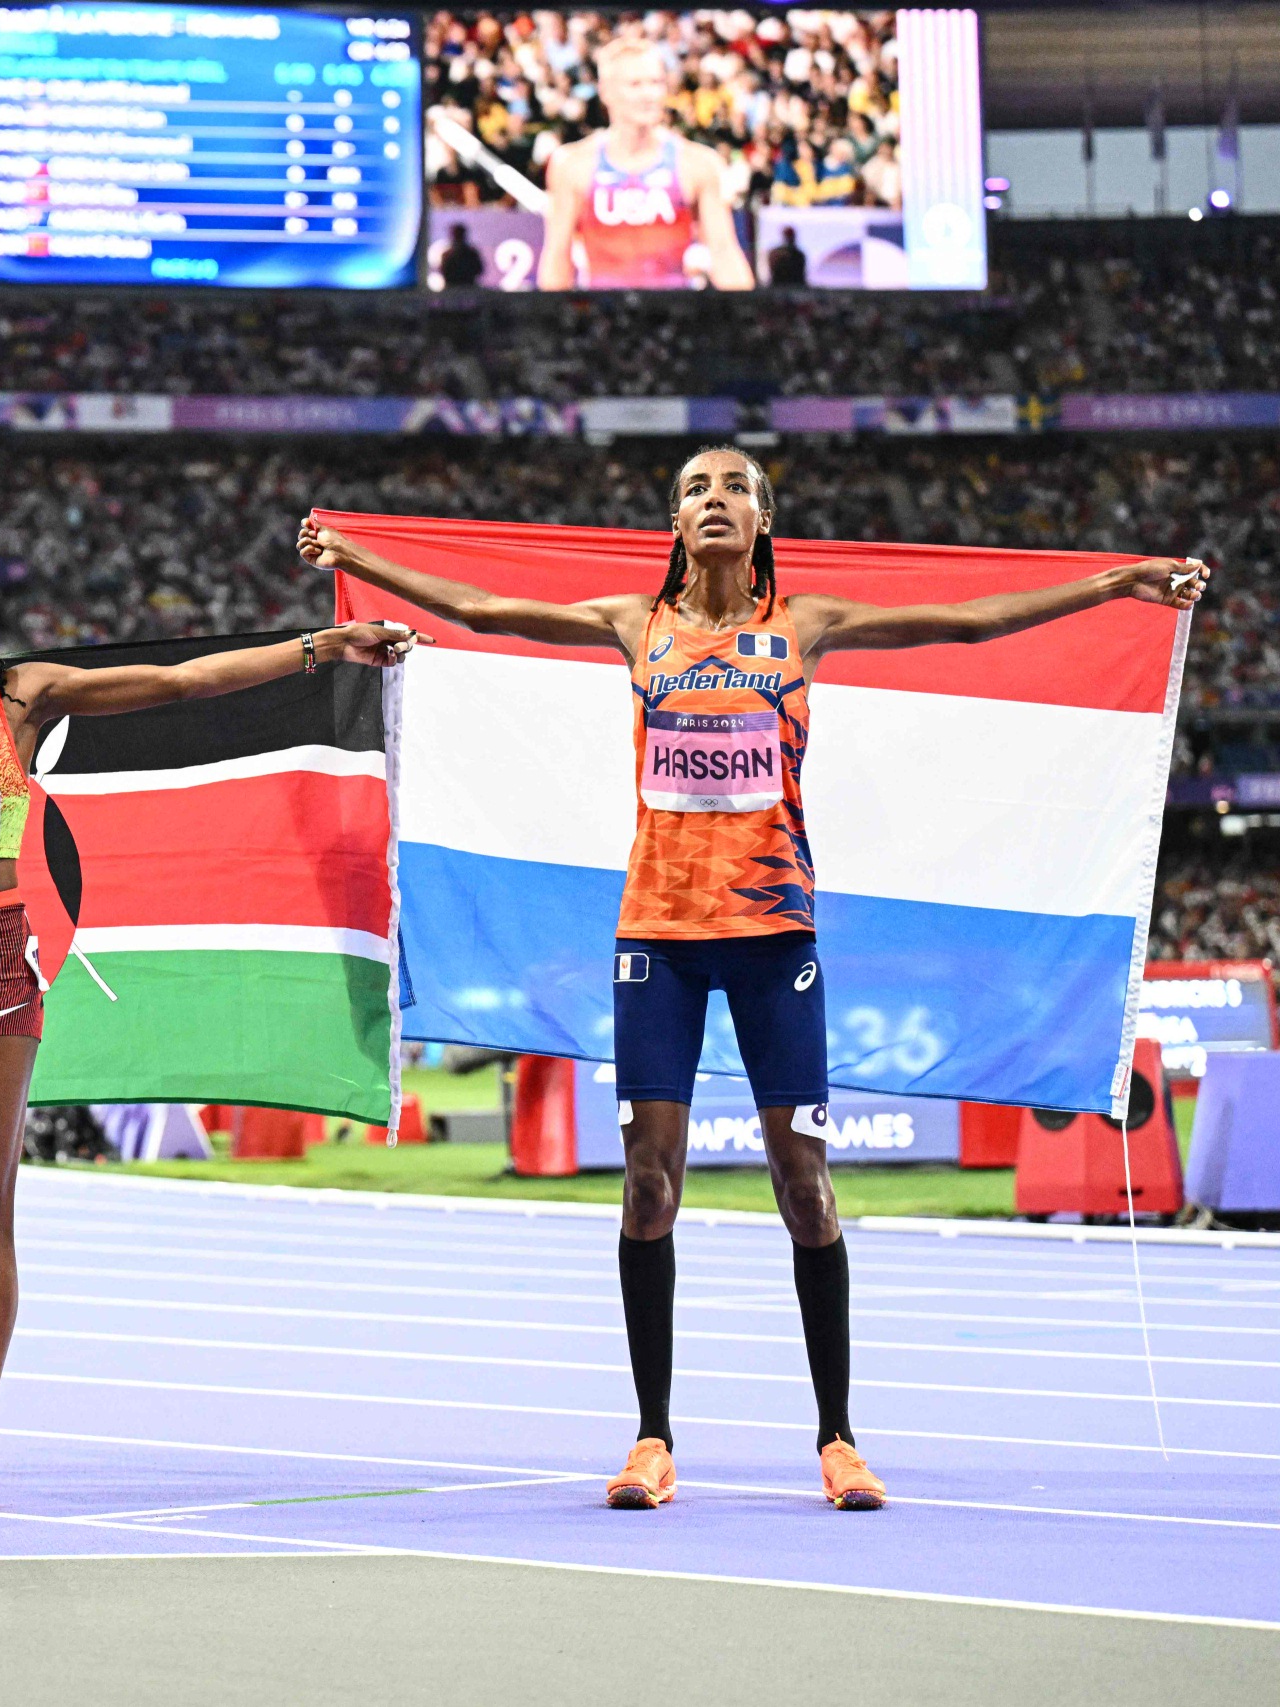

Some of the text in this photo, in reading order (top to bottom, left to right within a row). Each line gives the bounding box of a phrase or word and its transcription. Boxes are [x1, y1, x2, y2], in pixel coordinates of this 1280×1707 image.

[594, 187, 676, 226] USA
[676, 717, 744, 728] PARIS 2024
[653, 746, 773, 780] HASSAN
[827, 1112, 915, 1149] AMES
